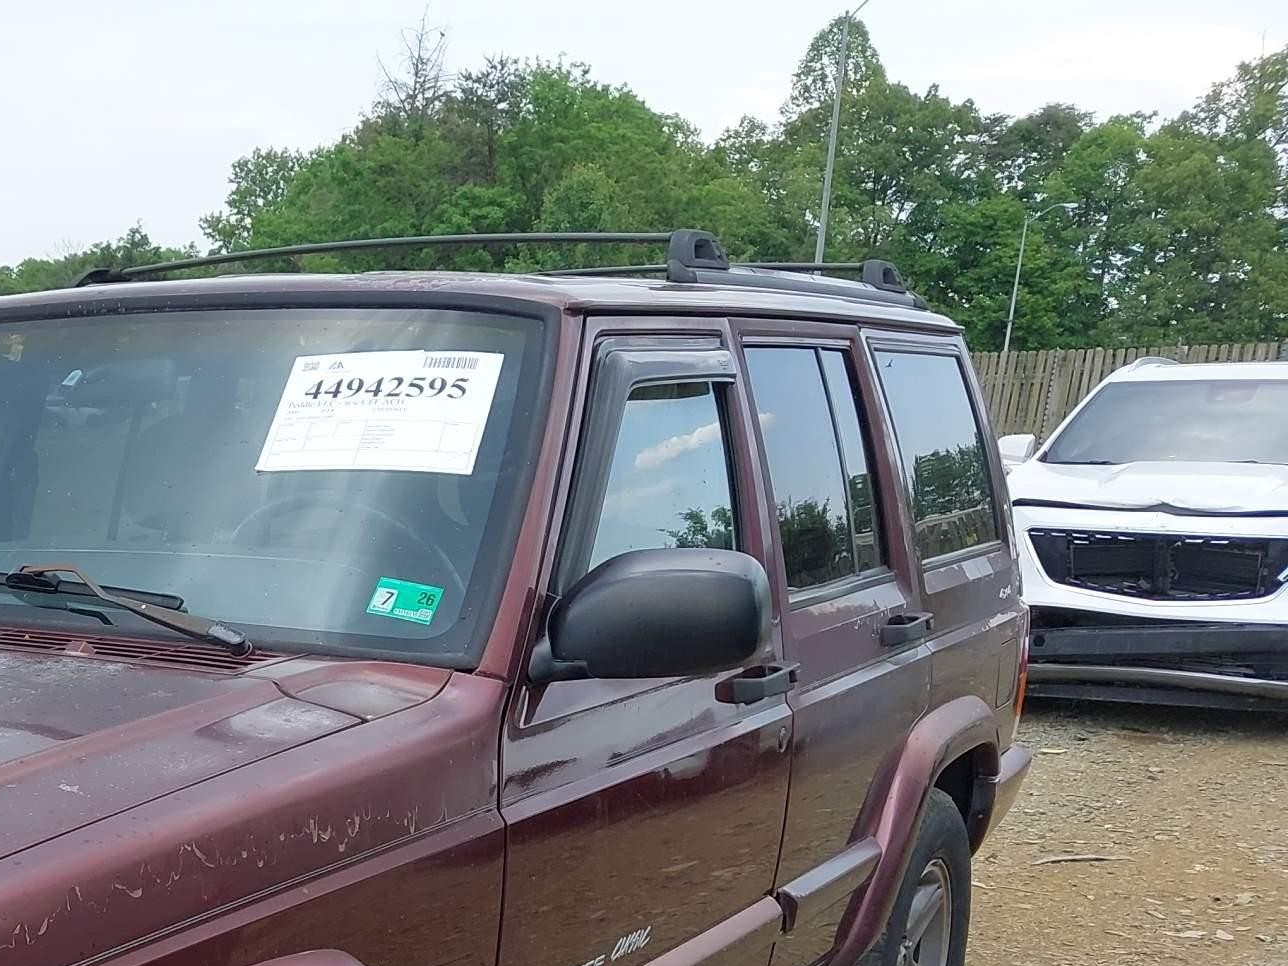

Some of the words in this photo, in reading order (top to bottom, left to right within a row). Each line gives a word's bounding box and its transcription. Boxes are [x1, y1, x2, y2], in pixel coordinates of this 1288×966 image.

[304, 375, 472, 400] 44942595
[381, 591, 395, 605] 7
[416, 591, 437, 607] 26
